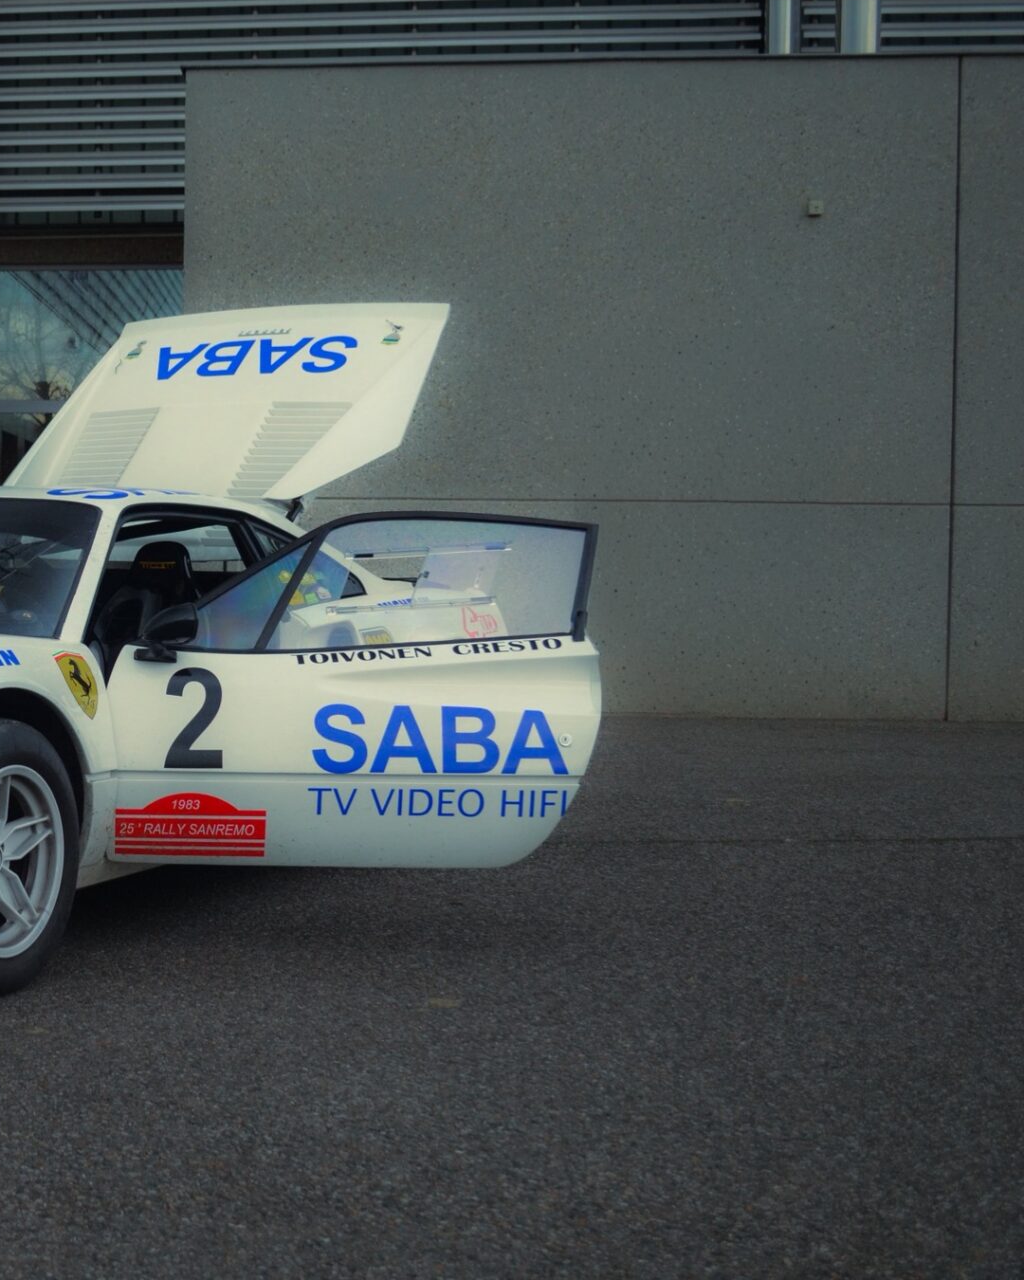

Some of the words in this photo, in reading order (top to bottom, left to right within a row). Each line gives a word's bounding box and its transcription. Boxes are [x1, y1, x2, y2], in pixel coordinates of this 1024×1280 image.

[156, 335, 359, 381] SABA
[291, 646, 432, 666] TOIVONEN
[451, 637, 563, 656] CRESTO
[163, 666, 224, 769] 2
[310, 703, 570, 776] SABA
[171, 799, 201, 811] 1983
[307, 787, 358, 816] TV
[370, 788, 486, 818] VIDEO
[500, 788, 568, 818] HIFI
[143, 823, 187, 836] RALLY
[188, 824, 256, 837] SANREMO
